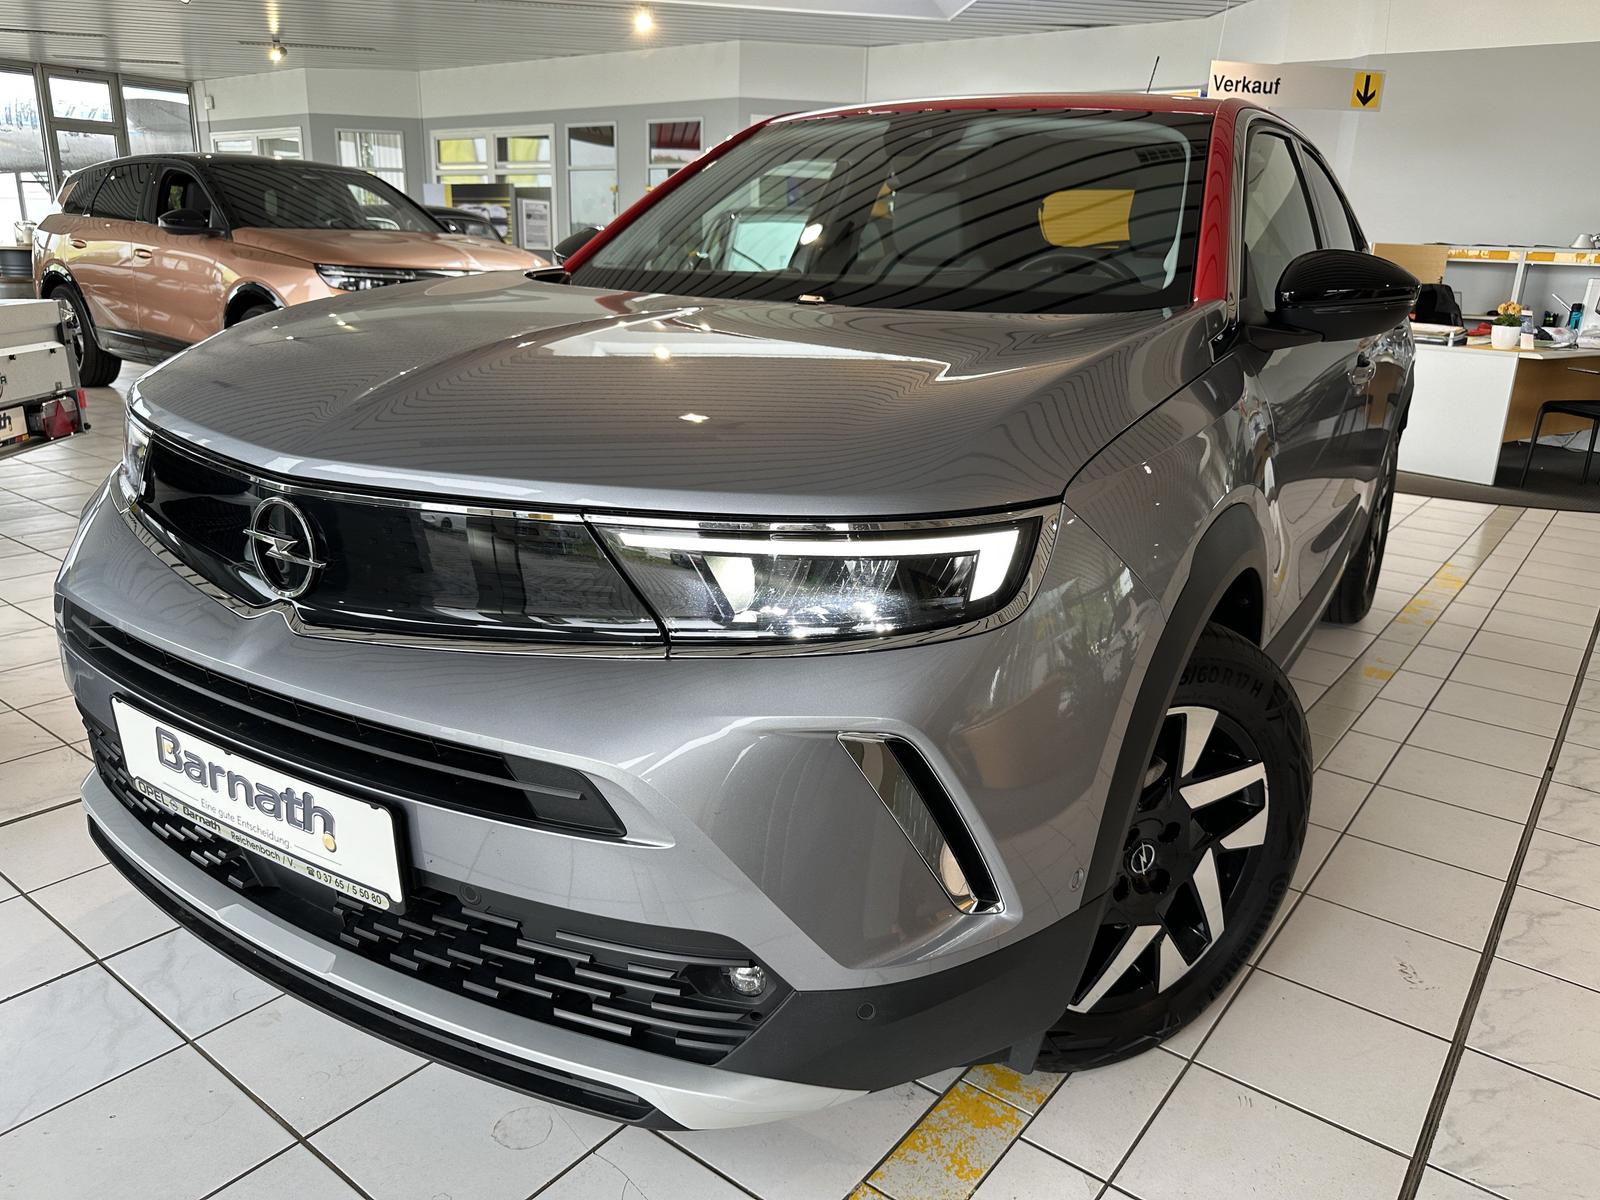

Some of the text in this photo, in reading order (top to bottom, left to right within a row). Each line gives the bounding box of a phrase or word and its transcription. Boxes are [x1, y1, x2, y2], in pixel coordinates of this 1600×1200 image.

[1213, 74, 1282, 95] Verkauf
[1223, 667, 1233, 687] R
[1236, 670, 1250, 689] 17
[155, 726, 337, 852] Barnath
[138, 780, 170, 808] OPEL
[182, 805, 221, 832] Barnath
[230, 831, 281, 862] Reichenbach
[323, 873, 333, 885] 37
[335, 878, 345, 889] 65
[371, 892, 382, 905] 80
[201, 798, 293, 850] Eine gute Entscheidung.
